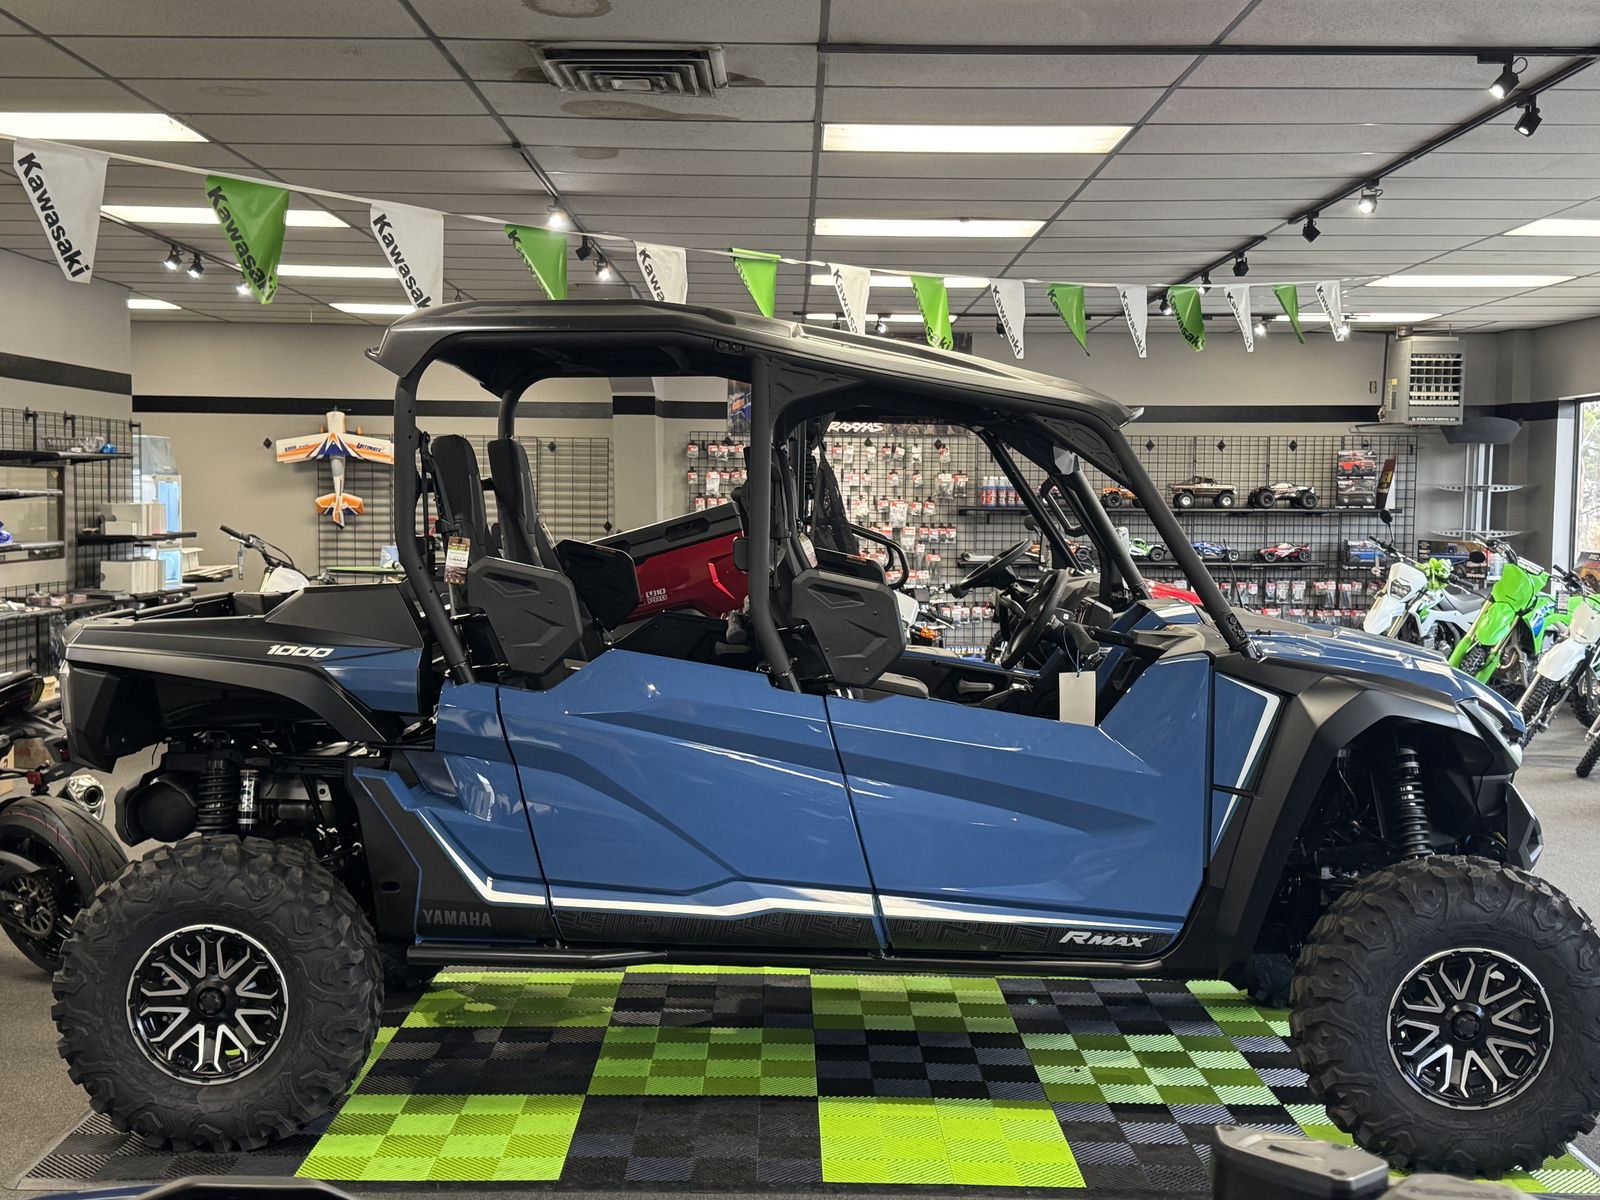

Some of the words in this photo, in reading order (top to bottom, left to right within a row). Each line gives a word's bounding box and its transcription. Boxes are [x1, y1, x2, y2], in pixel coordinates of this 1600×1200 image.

[17, 152, 91, 278] Kawasaki
[373, 213, 432, 309] Kawasak
[639, 249, 665, 302] Kawa
[833, 269, 858, 334] Kawasa
[993, 285, 1022, 356] Kawasaki
[1122, 291, 1145, 355] Kawasaki
[827, 421, 884, 433] RAXXAS
[267, 645, 334, 658] 1000
[423, 909, 492, 927] YAMAHA
[1059, 931, 1150, 947] RMAX
